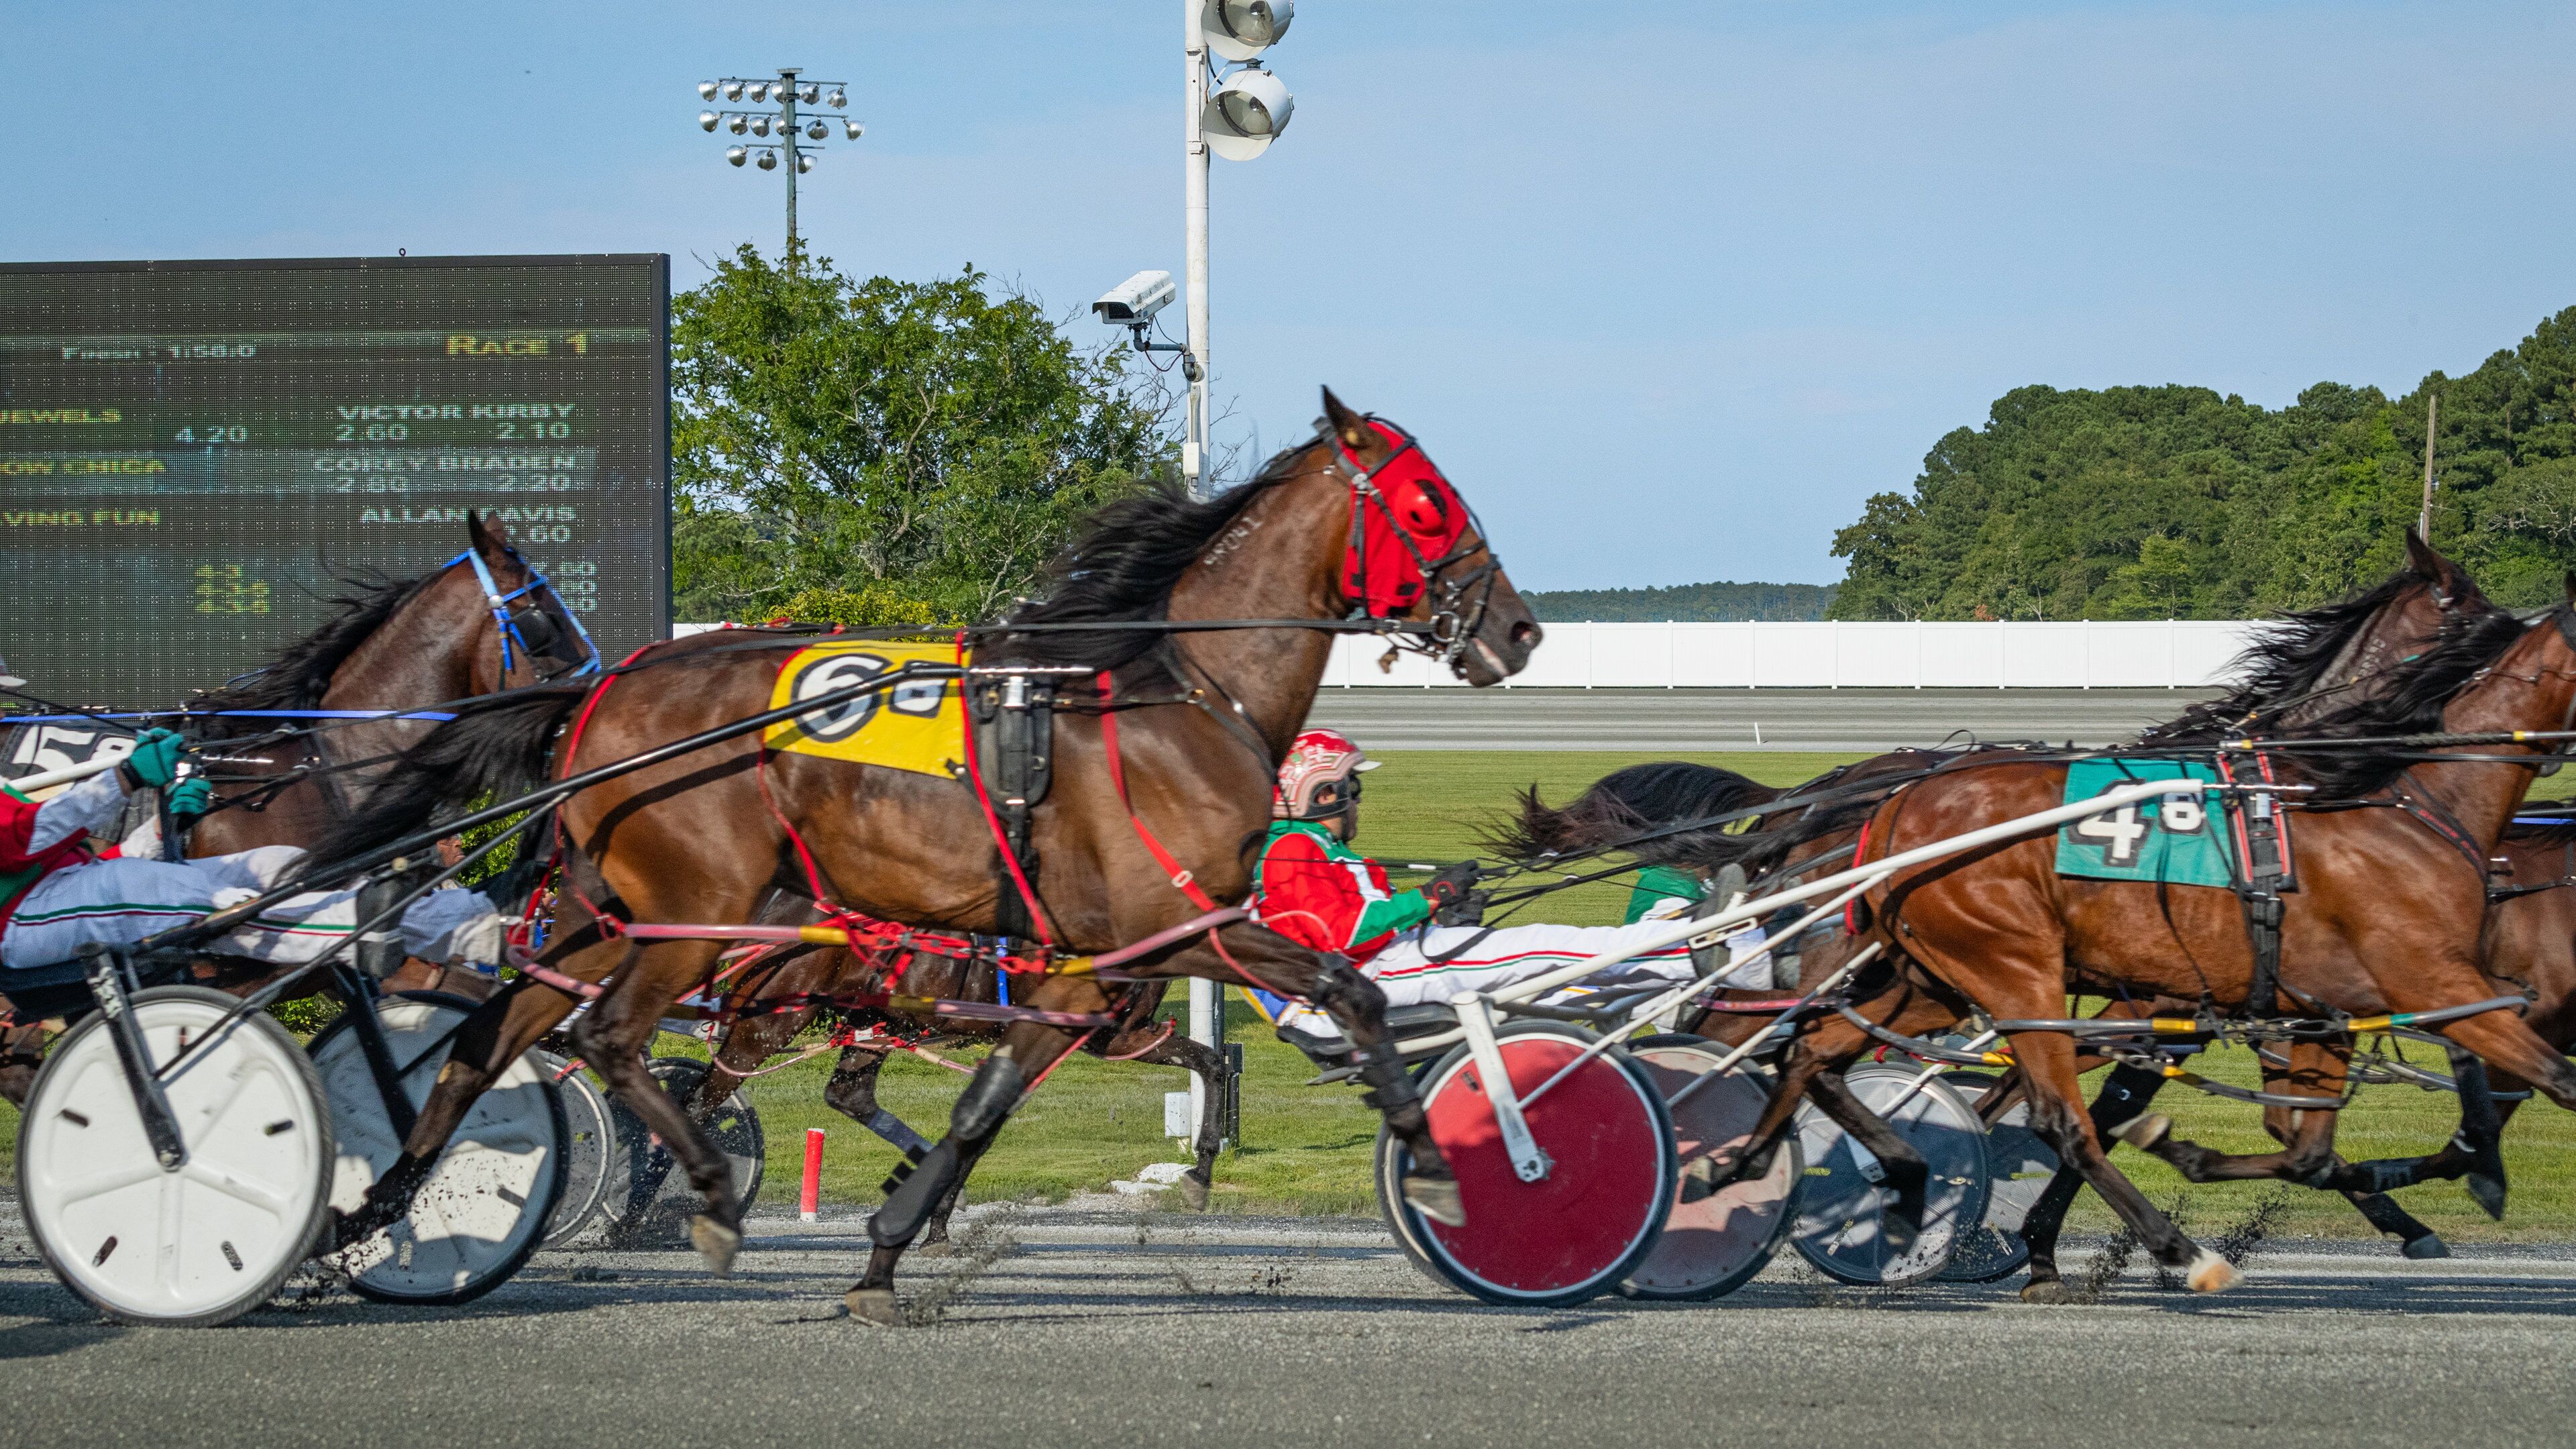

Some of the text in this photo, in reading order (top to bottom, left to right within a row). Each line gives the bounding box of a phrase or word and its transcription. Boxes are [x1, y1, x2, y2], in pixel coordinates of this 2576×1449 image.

[566, 333, 587, 354] 1
[339, 404, 575, 419] VICTOR KIRBY
[175, 422, 570, 443] 4.20 2.60 2.10
[64, 458, 165, 474] CHICA
[315, 456, 574, 472] COREY BRADEN
[496, 475, 570, 491] 2.20
[92, 510, 160, 525] FUN
[360, 508, 468, 522] ALLAN
